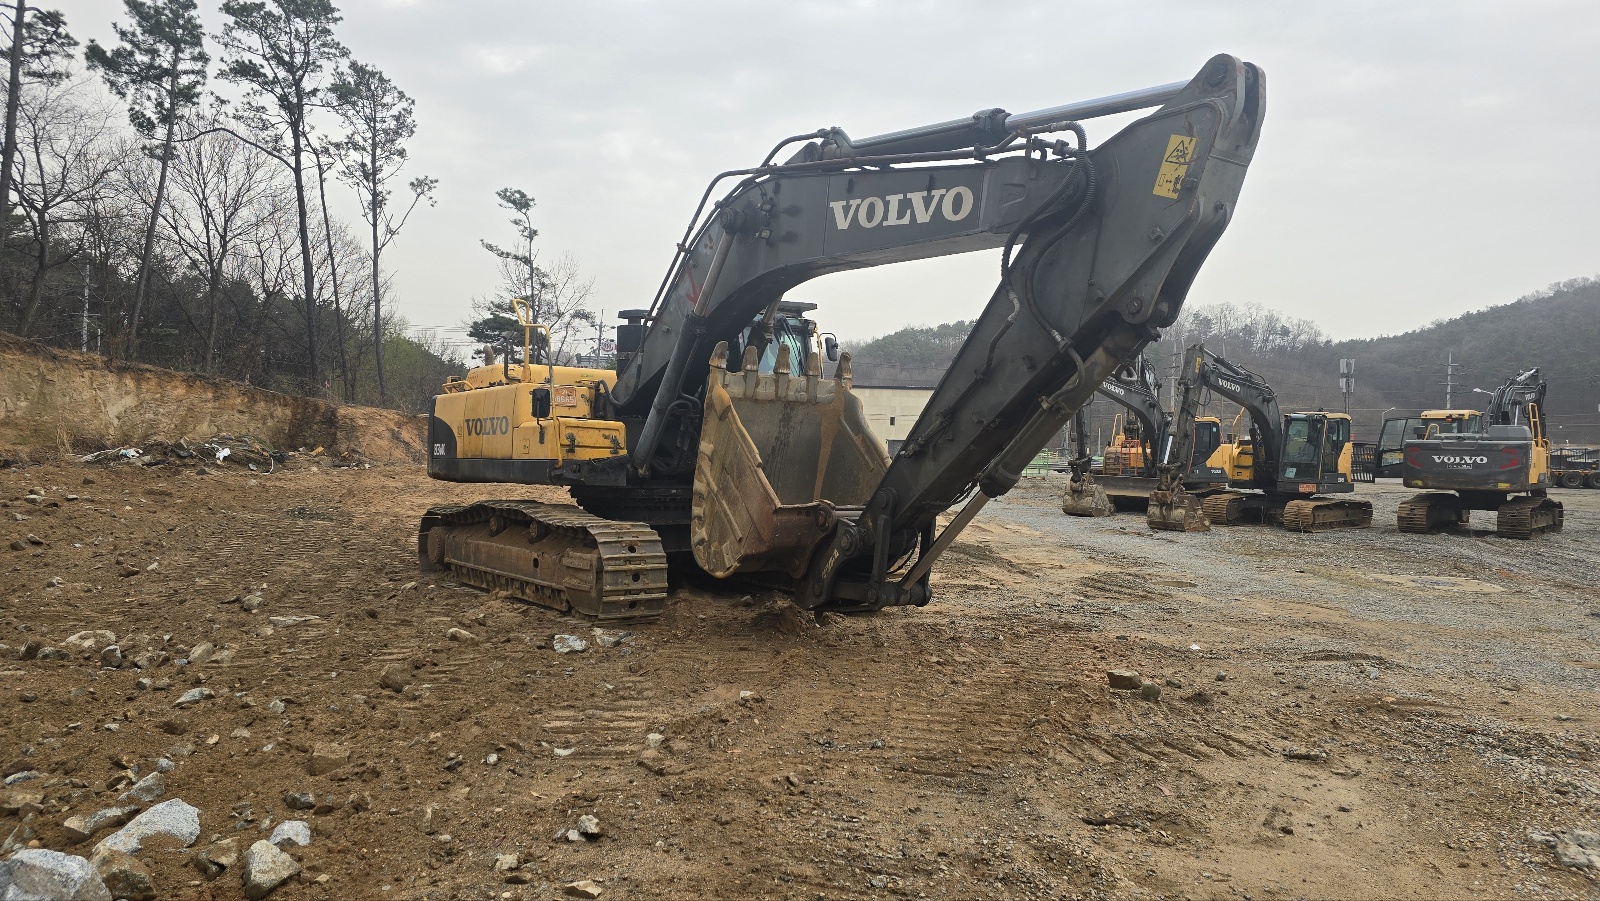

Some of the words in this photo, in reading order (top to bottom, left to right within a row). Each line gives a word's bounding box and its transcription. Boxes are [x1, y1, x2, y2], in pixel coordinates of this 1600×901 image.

[830, 186, 974, 230] VOLVO
[1102, 381, 1125, 396] VOLVO
[1217, 378, 1241, 393] VOLVO
[465, 415, 509, 436] VOLVO
[1431, 455, 1488, 464] VOLVO
